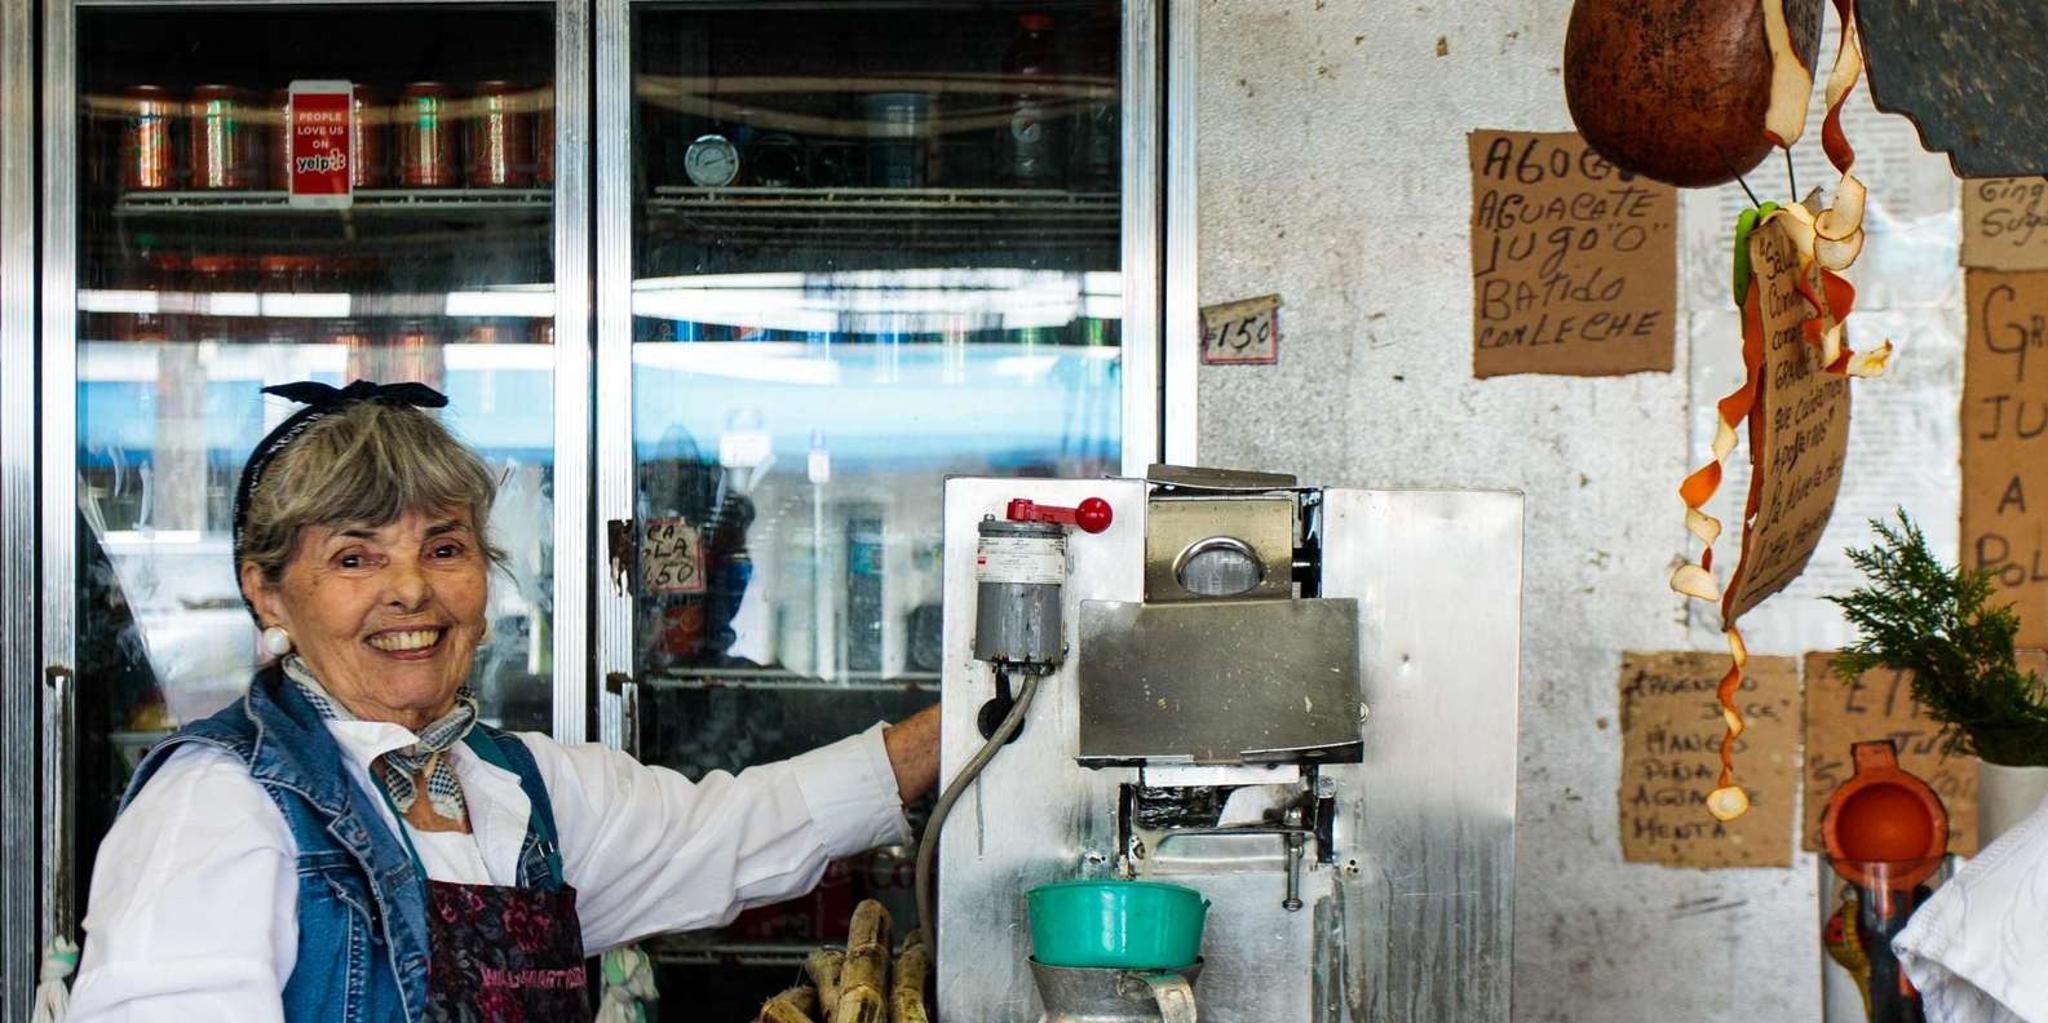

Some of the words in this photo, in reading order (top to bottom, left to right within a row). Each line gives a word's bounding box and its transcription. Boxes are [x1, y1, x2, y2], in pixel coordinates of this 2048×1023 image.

[299, 111, 342, 121] PEOPLE
[298, 125, 326, 136] LOVE
[329, 125, 344, 136] US
[312, 139, 330, 149] ON
[296, 154, 331, 174] yelp
